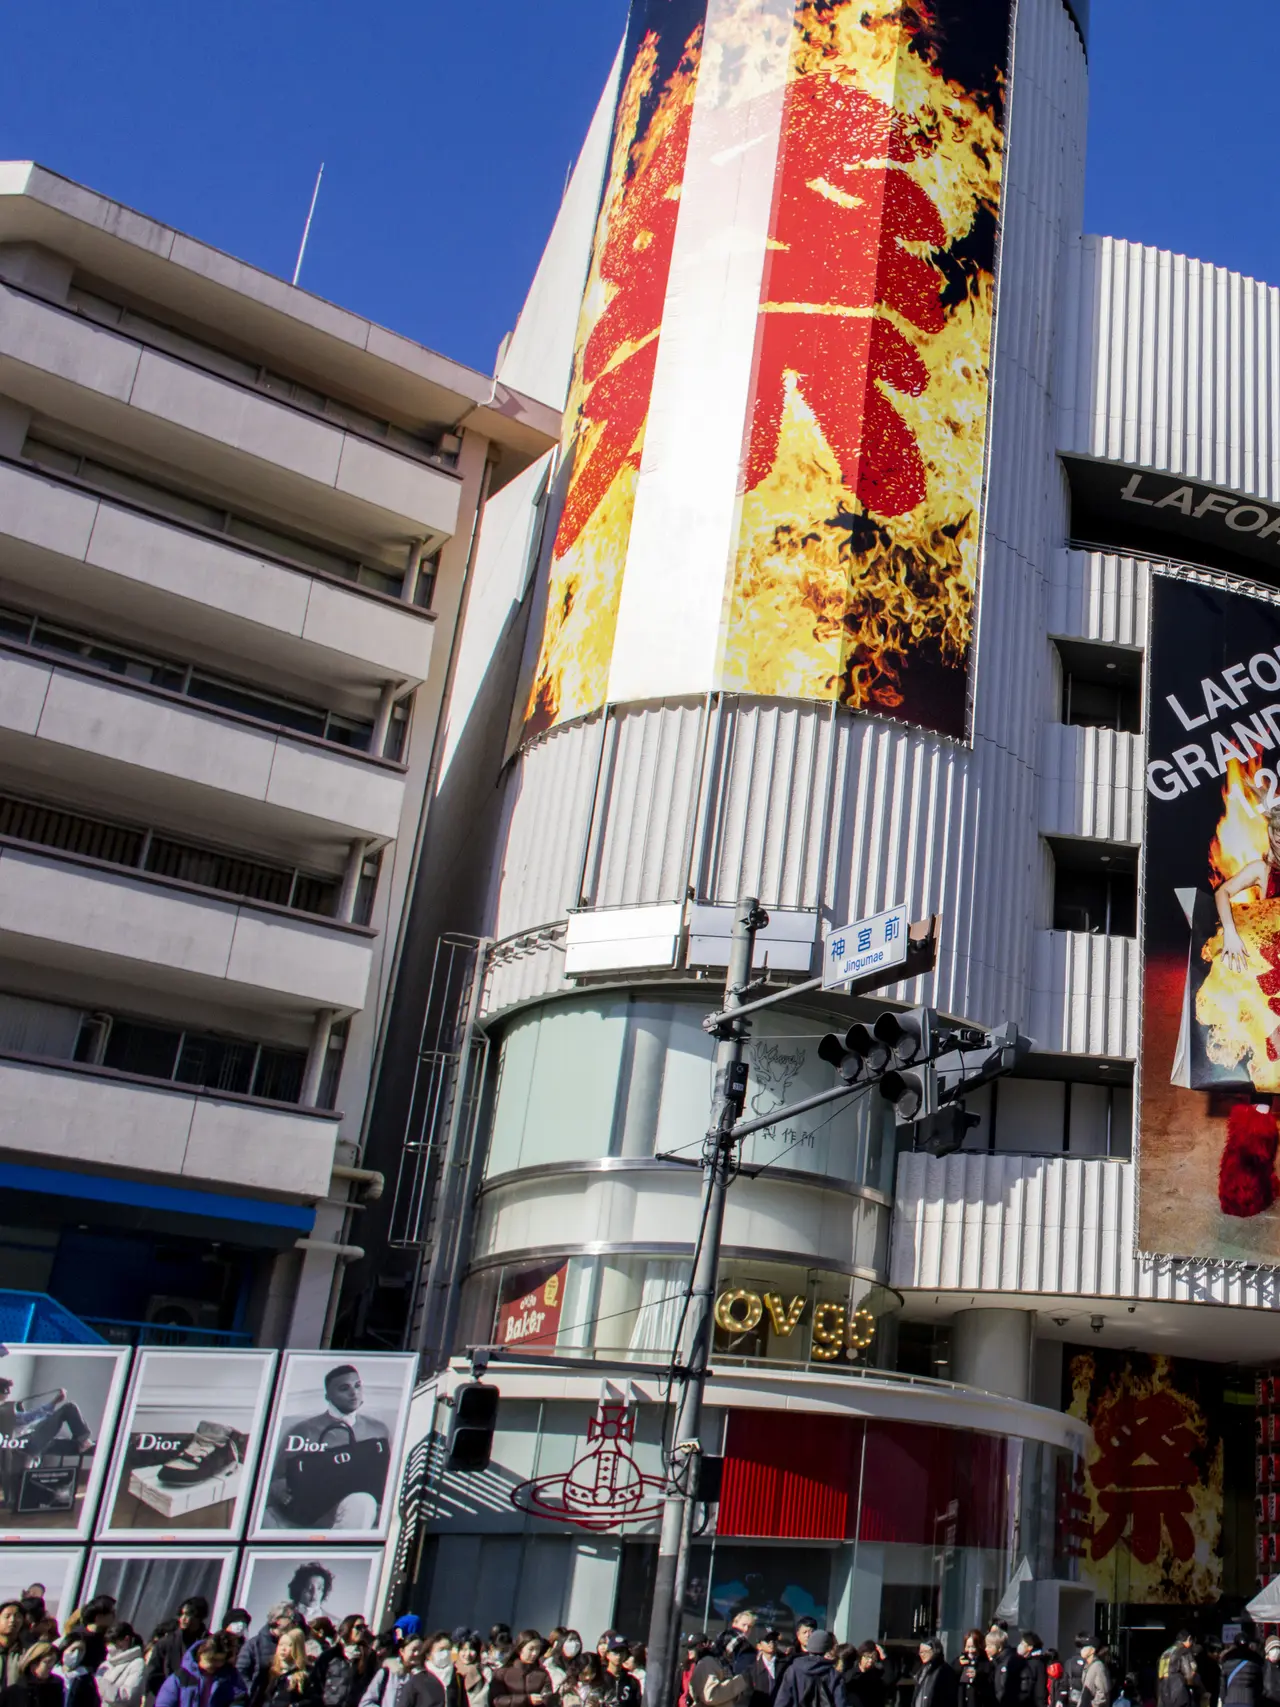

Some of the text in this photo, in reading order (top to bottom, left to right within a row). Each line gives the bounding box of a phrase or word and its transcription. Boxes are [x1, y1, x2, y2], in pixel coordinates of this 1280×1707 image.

[831, 915, 900, 962] 神宮前
[844, 950, 884, 974] Jingumae
[505, 1310, 545, 1343] Baker
[0, 1432, 28, 1449] ior
[137, 1433, 180, 1451] Dior
[286, 1435, 328, 1453] Dior
